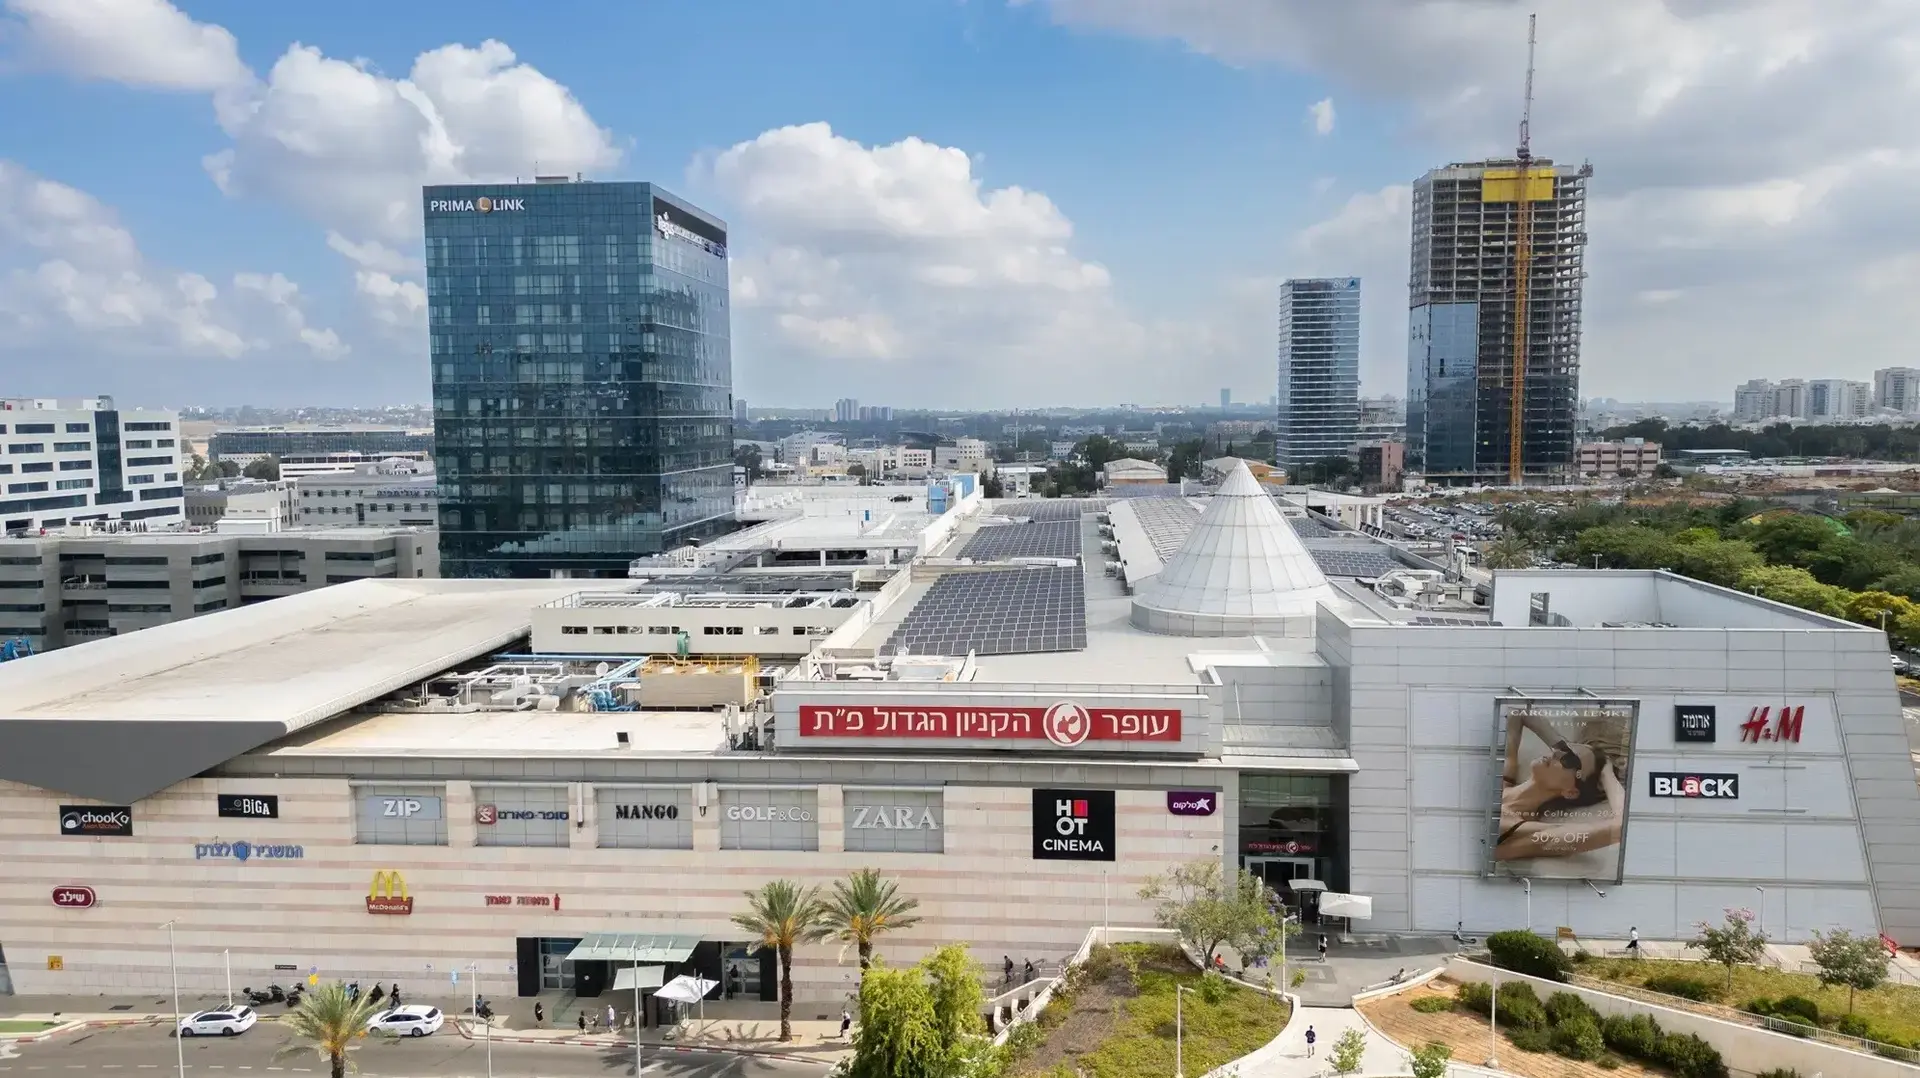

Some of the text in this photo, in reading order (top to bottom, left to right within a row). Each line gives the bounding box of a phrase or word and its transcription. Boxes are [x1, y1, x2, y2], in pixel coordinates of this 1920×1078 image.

[430, 200, 475, 211] PRIMA
[493, 199, 525, 211] LINK
[873, 707, 947, 732] הגדול
[1511, 709, 1580, 717] CAROLINA
[955, 711, 1030, 737] הקניון
[1101, 713, 1170, 735] עופר
[1682, 714, 1710, 728] ארומה
[1740, 706, 1804, 743] H&M
[383, 800, 421, 817] ZIP
[615, 805, 679, 820] MANGO
[1173, 801, 1197, 810] סלקום
[498, 811, 569, 820] סופר-פארם
[852, 806, 939, 830] ZARA
[1531, 831, 1590, 843] 50% OFF
[195, 842, 304, 860] המשביר לצרכן
[1043, 839, 1103, 852] CINEMA
[59, 892, 85, 902] שילב
